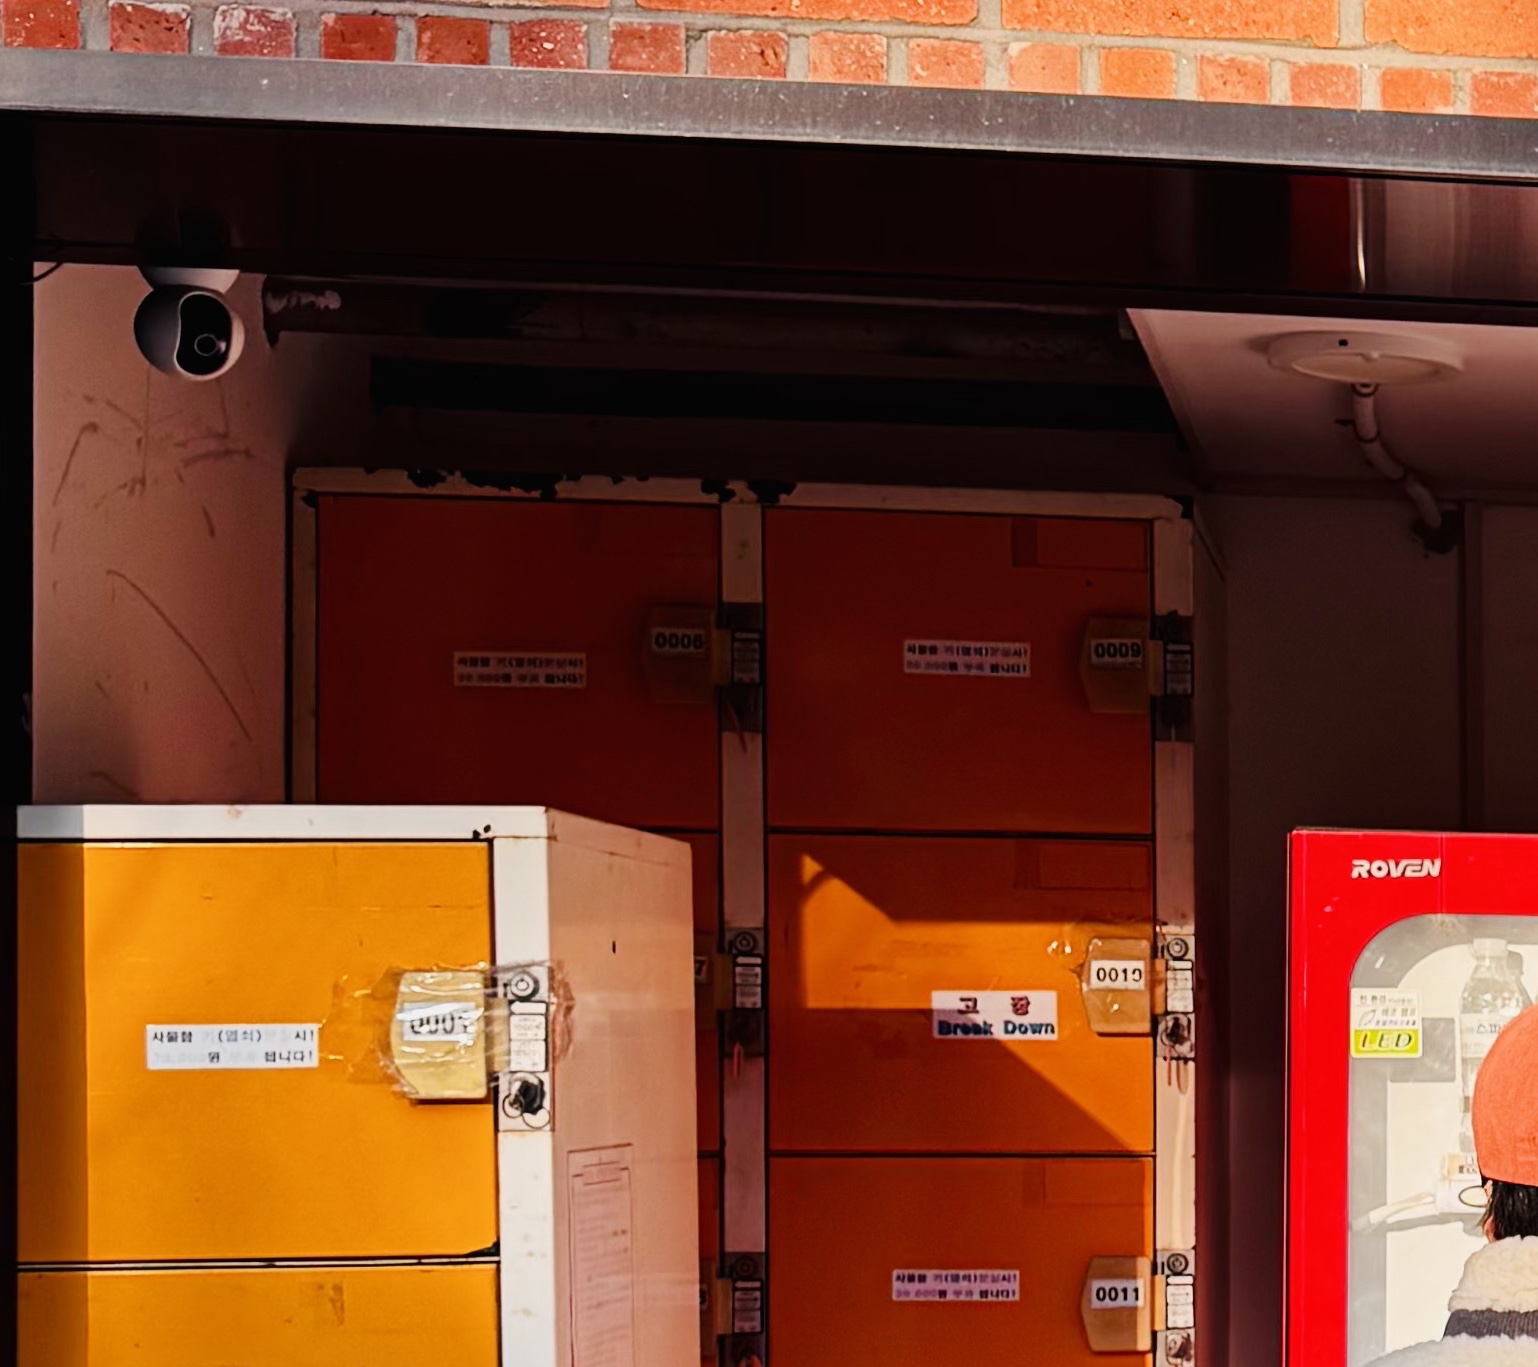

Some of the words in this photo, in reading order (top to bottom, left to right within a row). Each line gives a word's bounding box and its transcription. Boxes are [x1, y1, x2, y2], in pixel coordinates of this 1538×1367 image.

[1094, 642, 1142, 658] 0009
[1351, 858, 1442, 879] ROVEN
[937, 1019, 994, 1036] Break
[1003, 1020, 1055, 1036] Down
[1096, 1286, 1141, 1302] 0011
